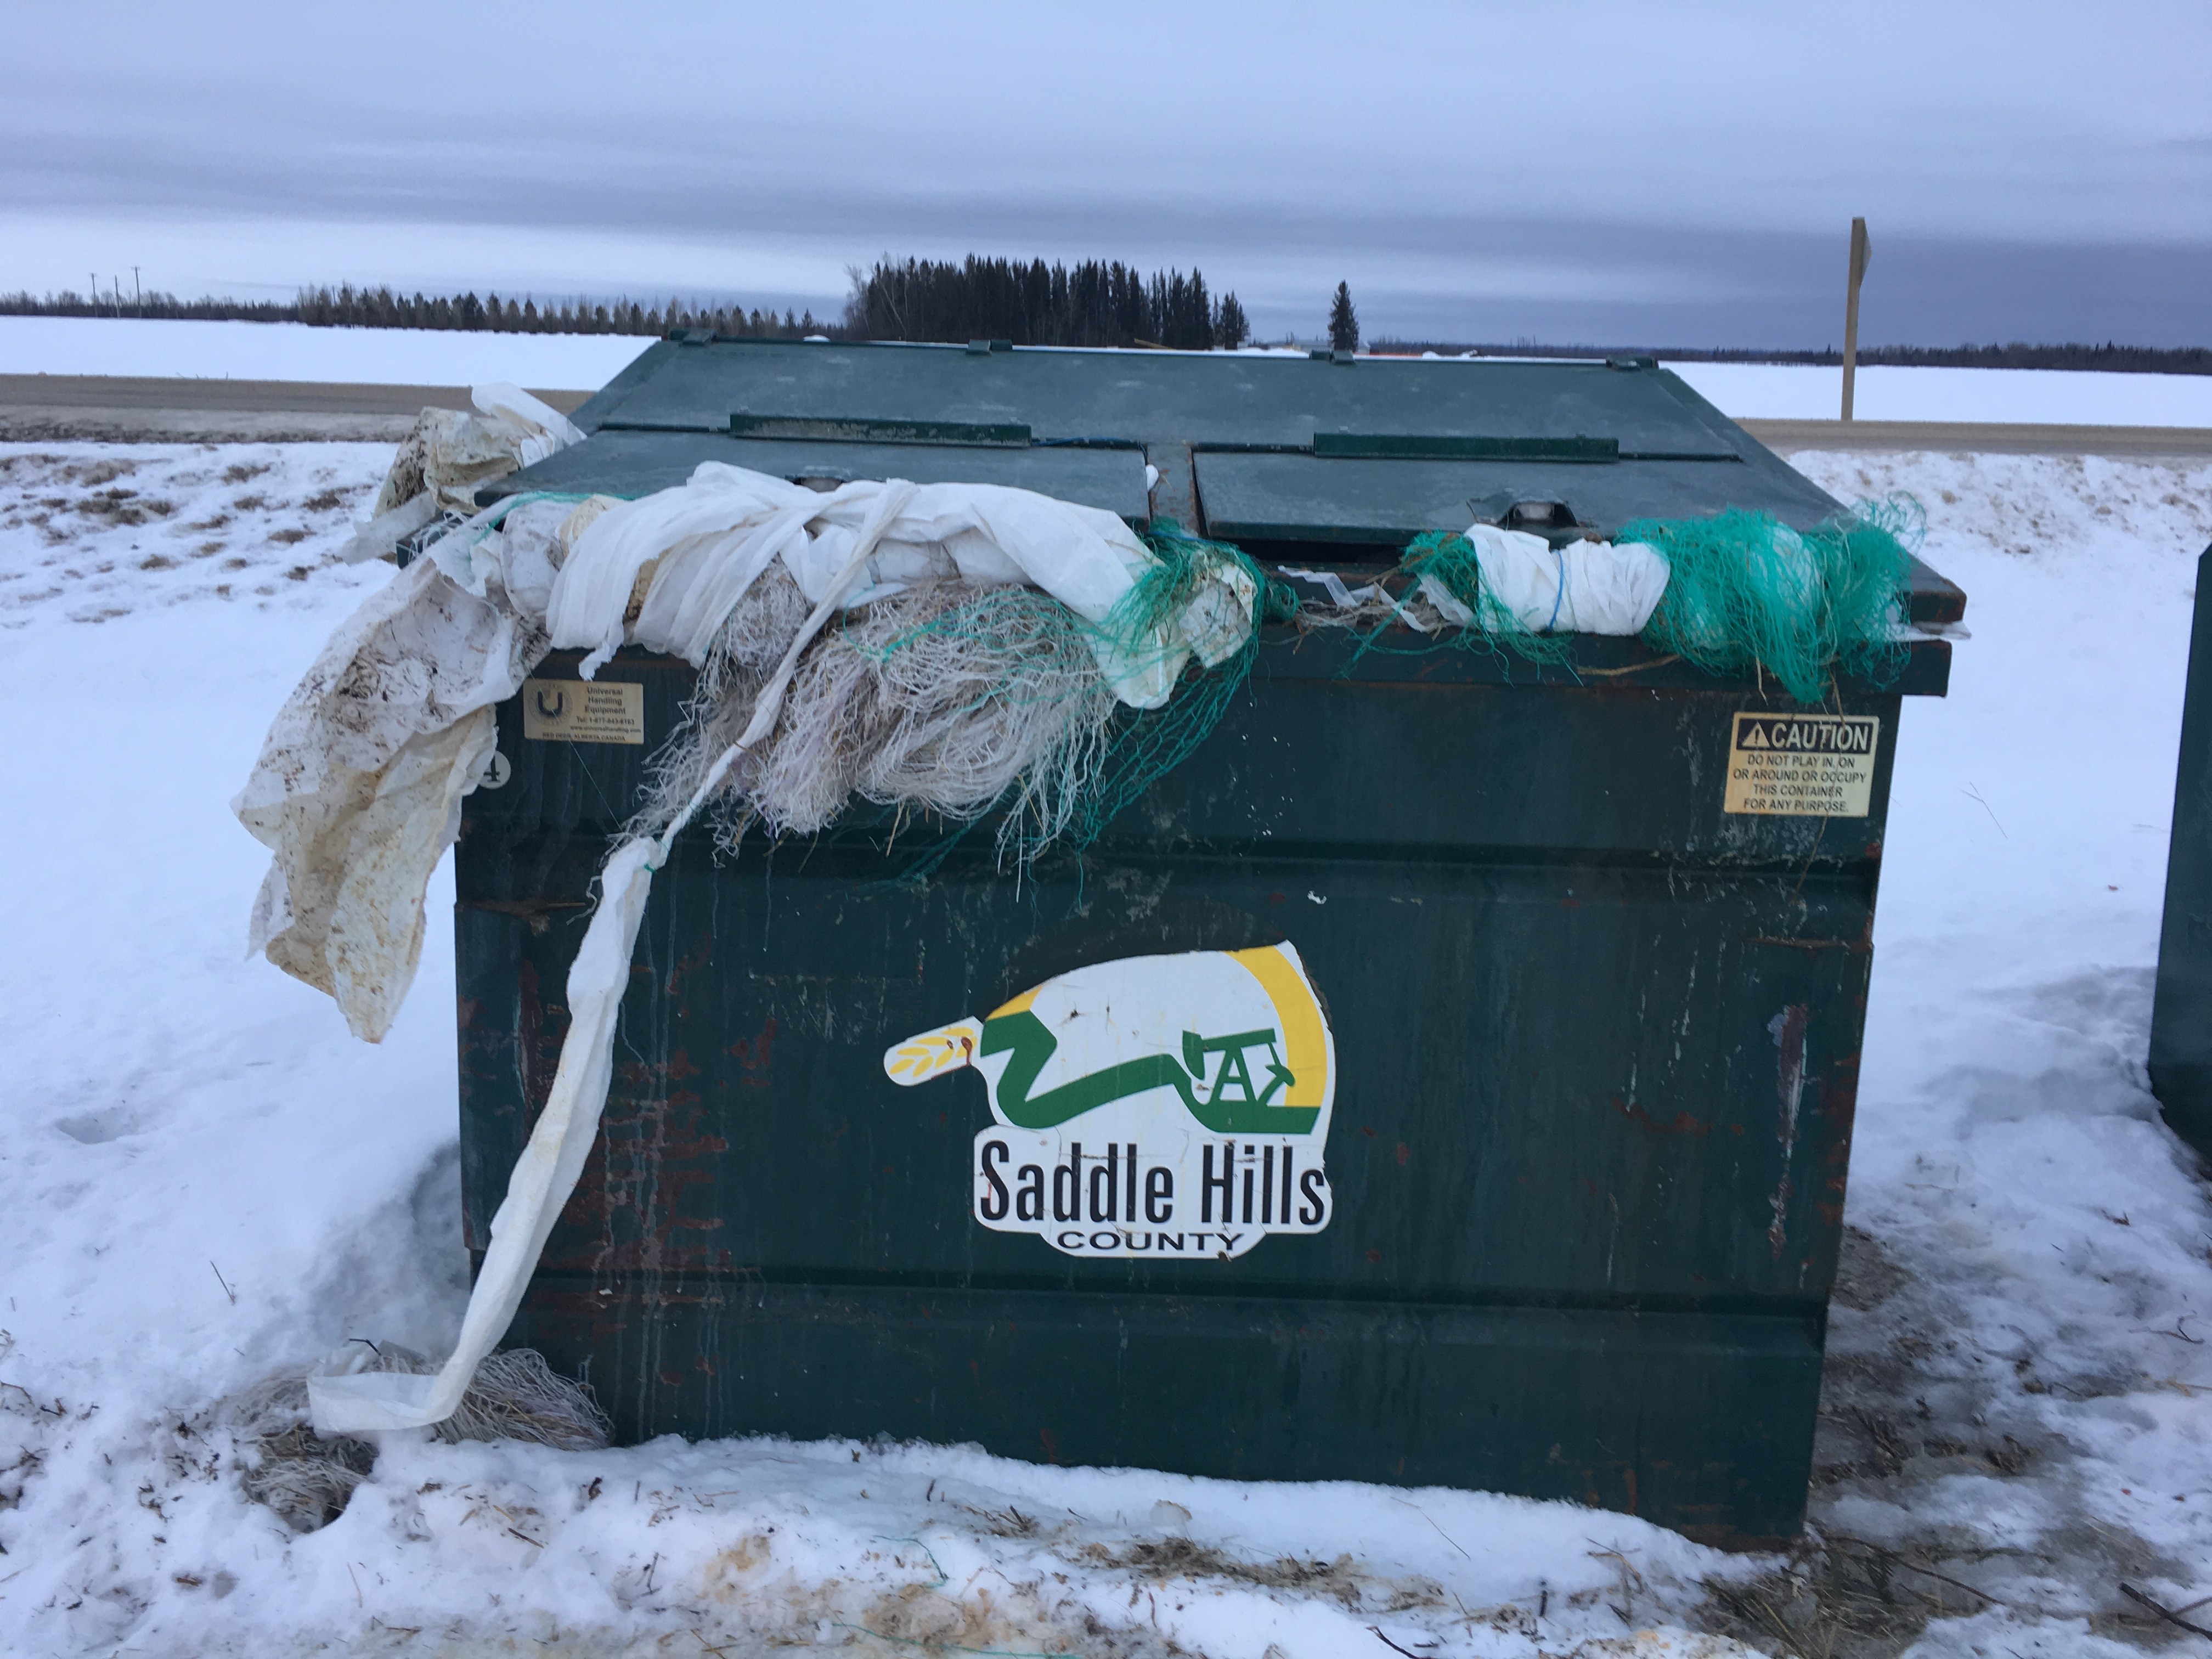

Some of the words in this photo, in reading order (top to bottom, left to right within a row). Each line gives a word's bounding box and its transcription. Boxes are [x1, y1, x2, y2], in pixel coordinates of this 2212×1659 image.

[586, 687, 623, 696] Universal
[588, 696, 622, 706] Handling
[585, 705, 627, 715] Equipment
[1771, 723, 1868, 751] CAUTION
[1747, 754, 1764, 765] DO
[1767, 754, 1790, 766] NOT
[1792, 755, 1820, 768] PLAY
[1822, 757, 1835, 769] IN,
[1838, 757, 1855, 768] ON
[1733, 768, 1749, 780] OR
[1752, 769, 1799, 781] AROUND
[1802, 770, 1818, 782] OR
[1821, 771, 1866, 783] OCCUPY
[1753, 783, 1777, 795] THIS
[1780, 785, 1843, 797] CONTAINER
[1743, 798, 1766, 810] FOR
[1769, 799, 1792, 811] ANY
[1795, 800, 1849, 812] PURPOSE.
[980, 1139, 1173, 1223] Saddle
[1201, 1142, 1324, 1225] Hills
[1057, 1231, 1245, 1251] COUNTY
